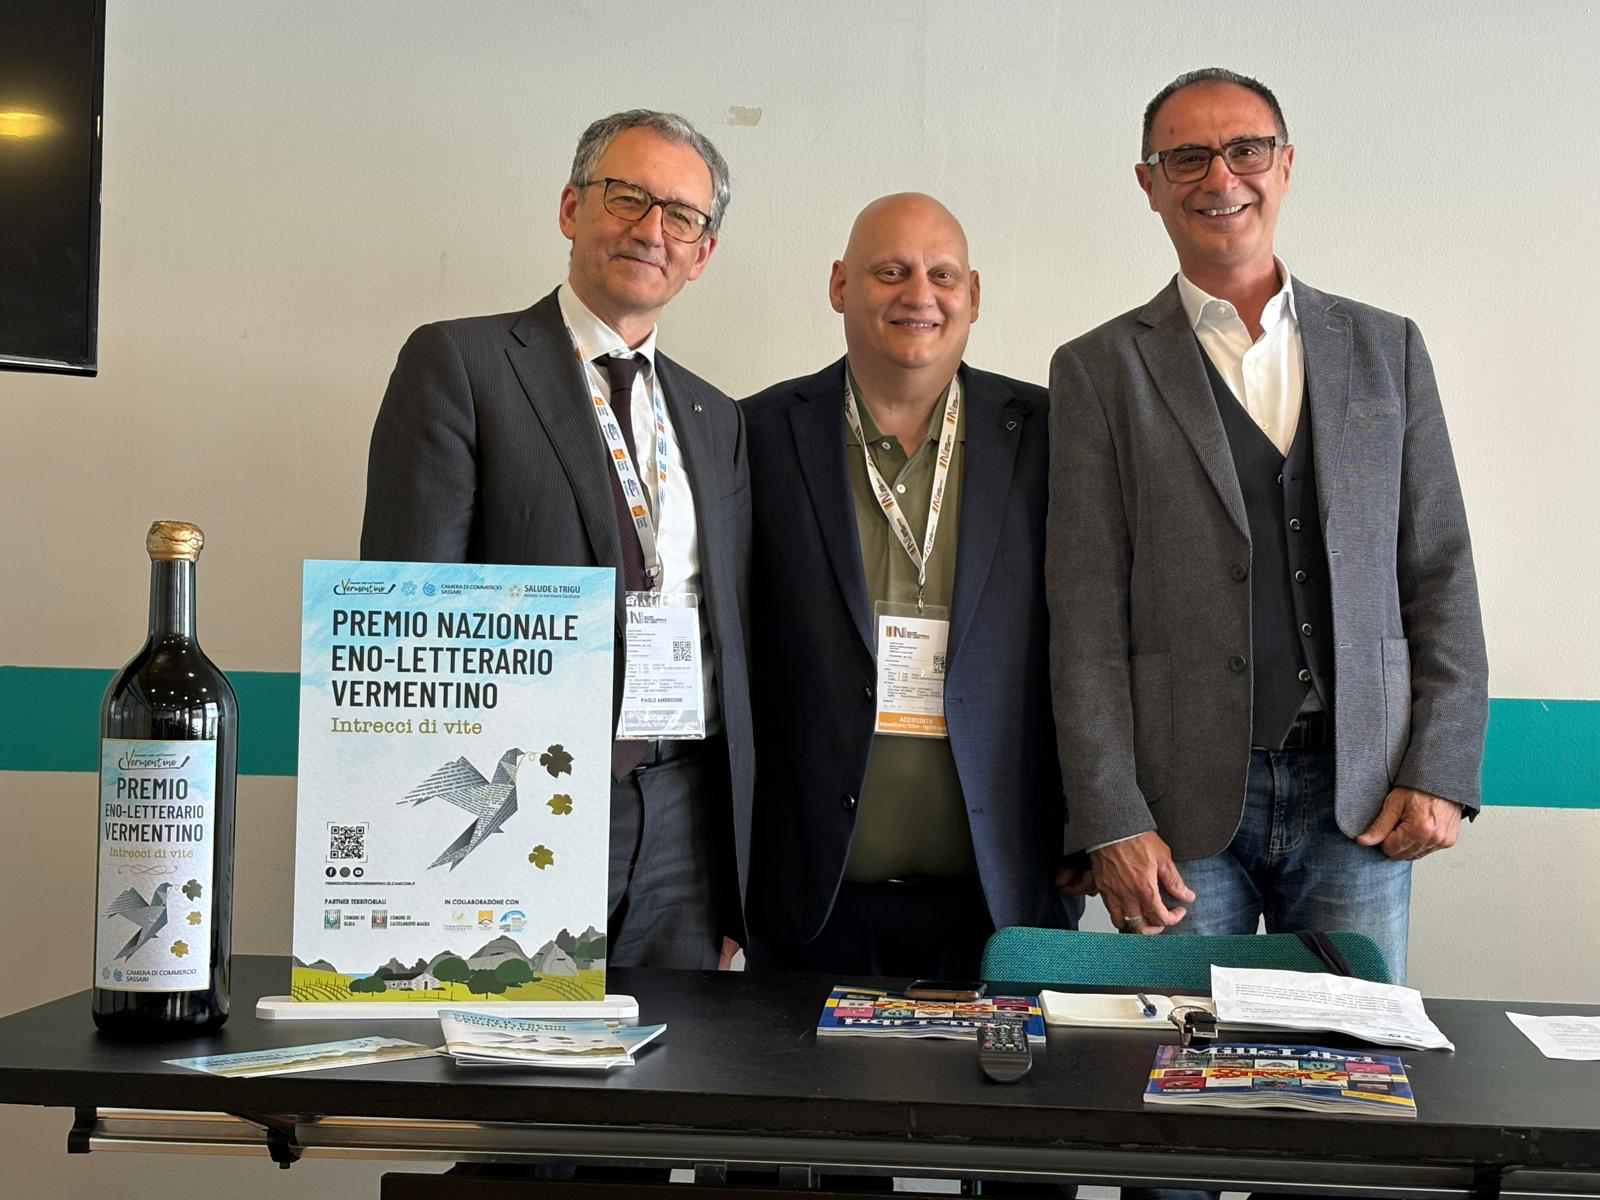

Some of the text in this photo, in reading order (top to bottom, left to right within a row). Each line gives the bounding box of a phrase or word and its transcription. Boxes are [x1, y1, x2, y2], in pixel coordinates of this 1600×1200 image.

[524, 584, 581, 594] SALUDE & TRIGU
[332, 609, 579, 641] PREMIO NAZIONALE
[331, 645, 553, 675] ENO-LETTERARIO
[331, 680, 498, 709] VERMENTINO
[330, 717, 482, 735] Intrecci di vite
[116, 778, 188, 800] PREMIO
[105, 804, 204, 820] ENO-LETTERARIO
[104, 823, 204, 842] VERMENTINO
[109, 847, 194, 859] Intrecci di vite
[159, 968, 197, 976] COMMERCIO
